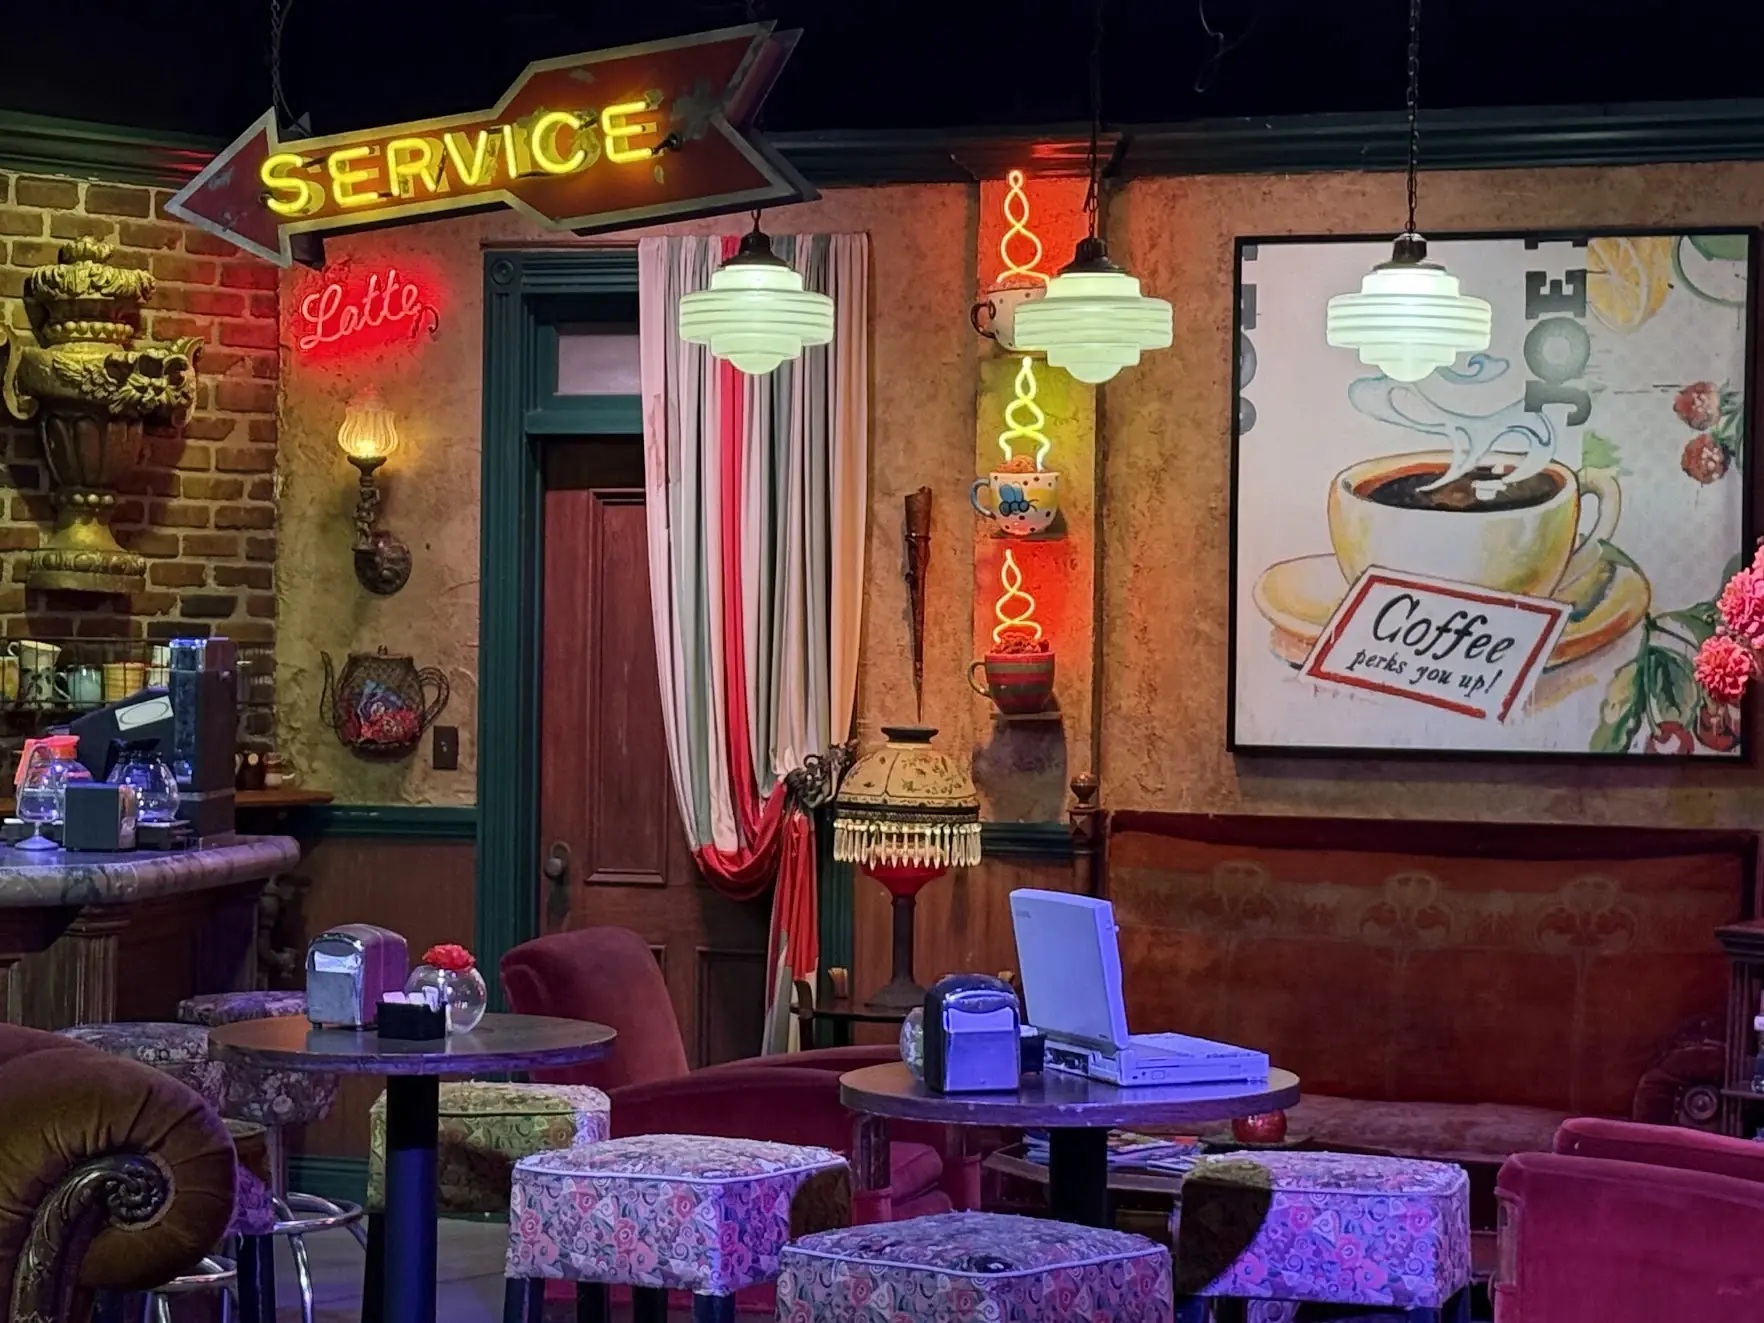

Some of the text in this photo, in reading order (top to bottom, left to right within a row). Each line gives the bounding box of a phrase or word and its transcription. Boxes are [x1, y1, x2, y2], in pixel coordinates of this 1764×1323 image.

[260, 101, 660, 216] SERVICE
[300, 269, 421, 350] Latte
[1524, 269, 1592, 426] JOE
[1373, 593, 1515, 664] Coffee
[1345, 649, 1503, 697] perks you up!
